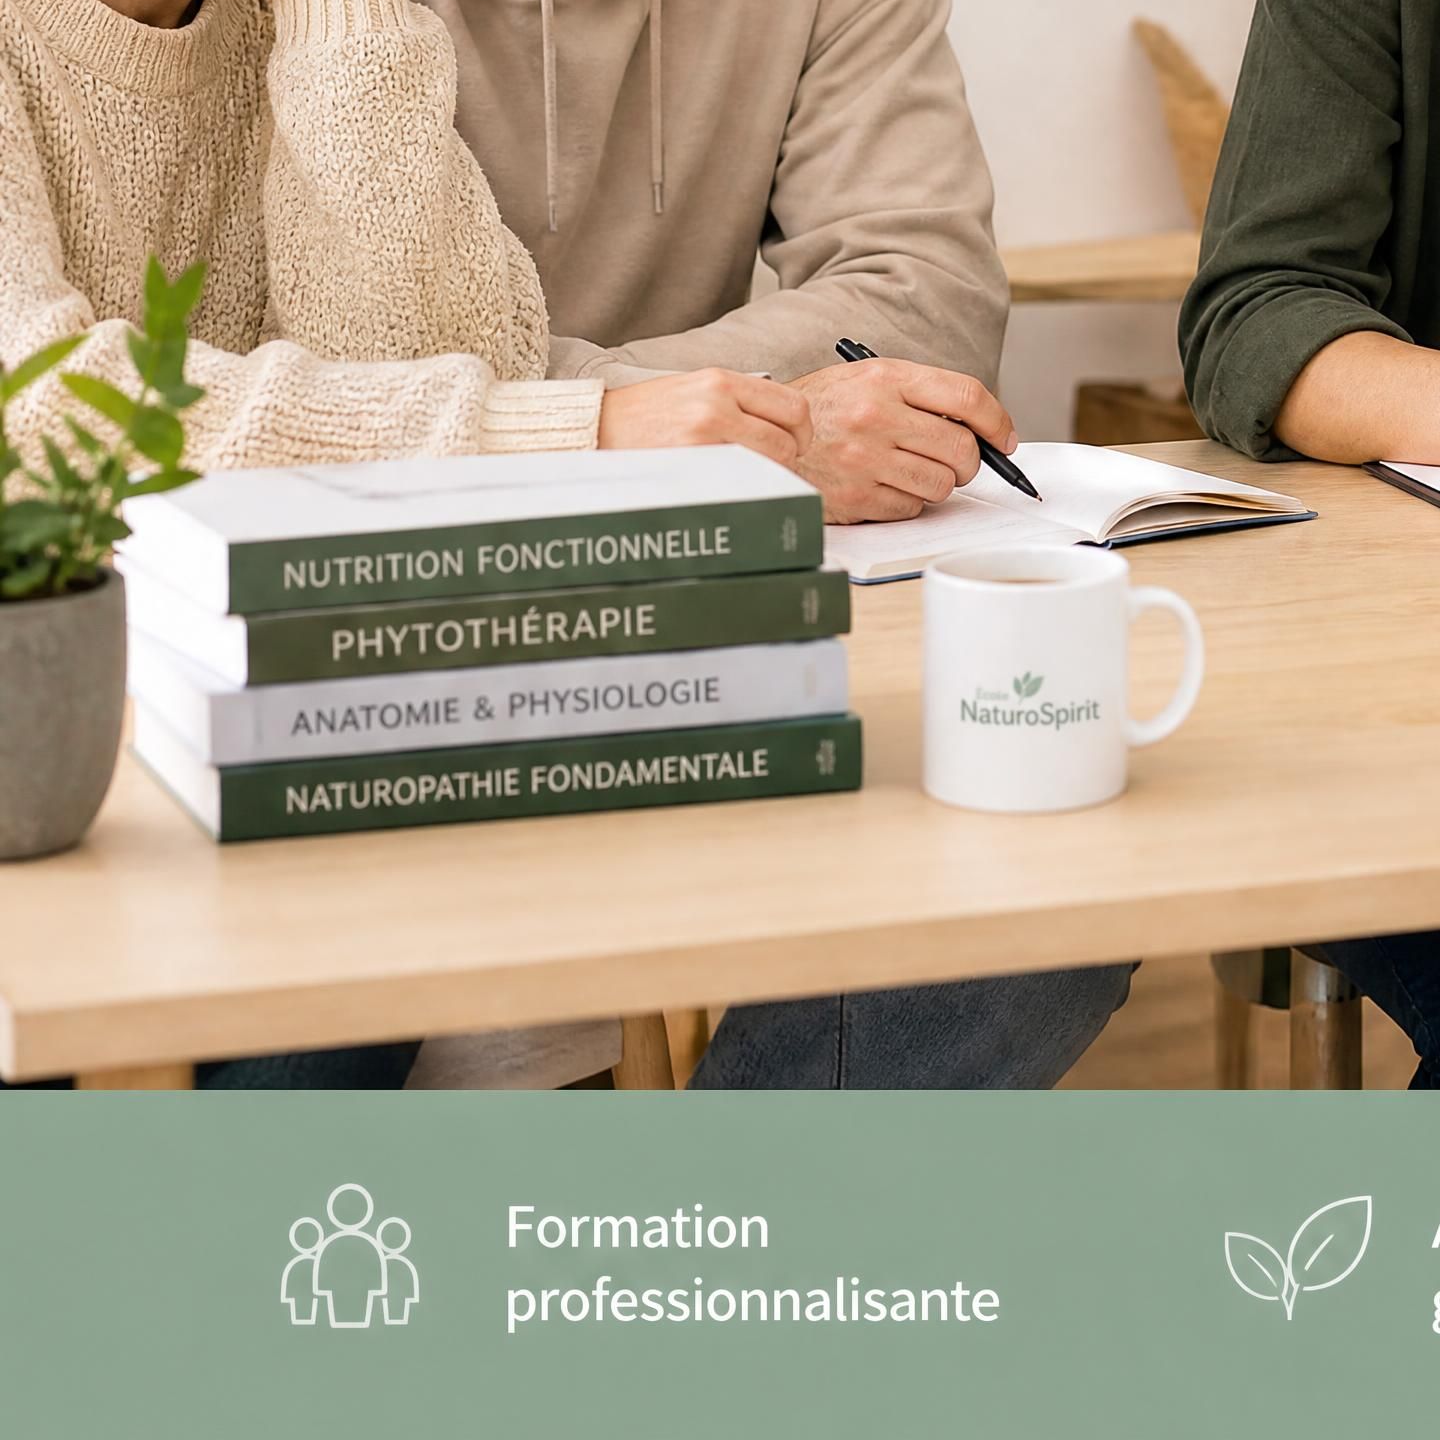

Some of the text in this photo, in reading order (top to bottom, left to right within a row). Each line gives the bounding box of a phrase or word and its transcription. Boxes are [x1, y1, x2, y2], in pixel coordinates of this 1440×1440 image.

[284, 550, 463, 590] NUTRITION
[477, 526, 731, 574] FONCTIONNELLE
[332, 605, 656, 660] PHYTOTHÉRAPIE
[291, 677, 720, 736] ANATOMIE & PHYSIOLOGIE
[960, 698, 1100, 731] NaturoSpirit
[286, 768, 519, 813] NATUROPATHIE
[531, 749, 769, 794] FONDAMENTALE
